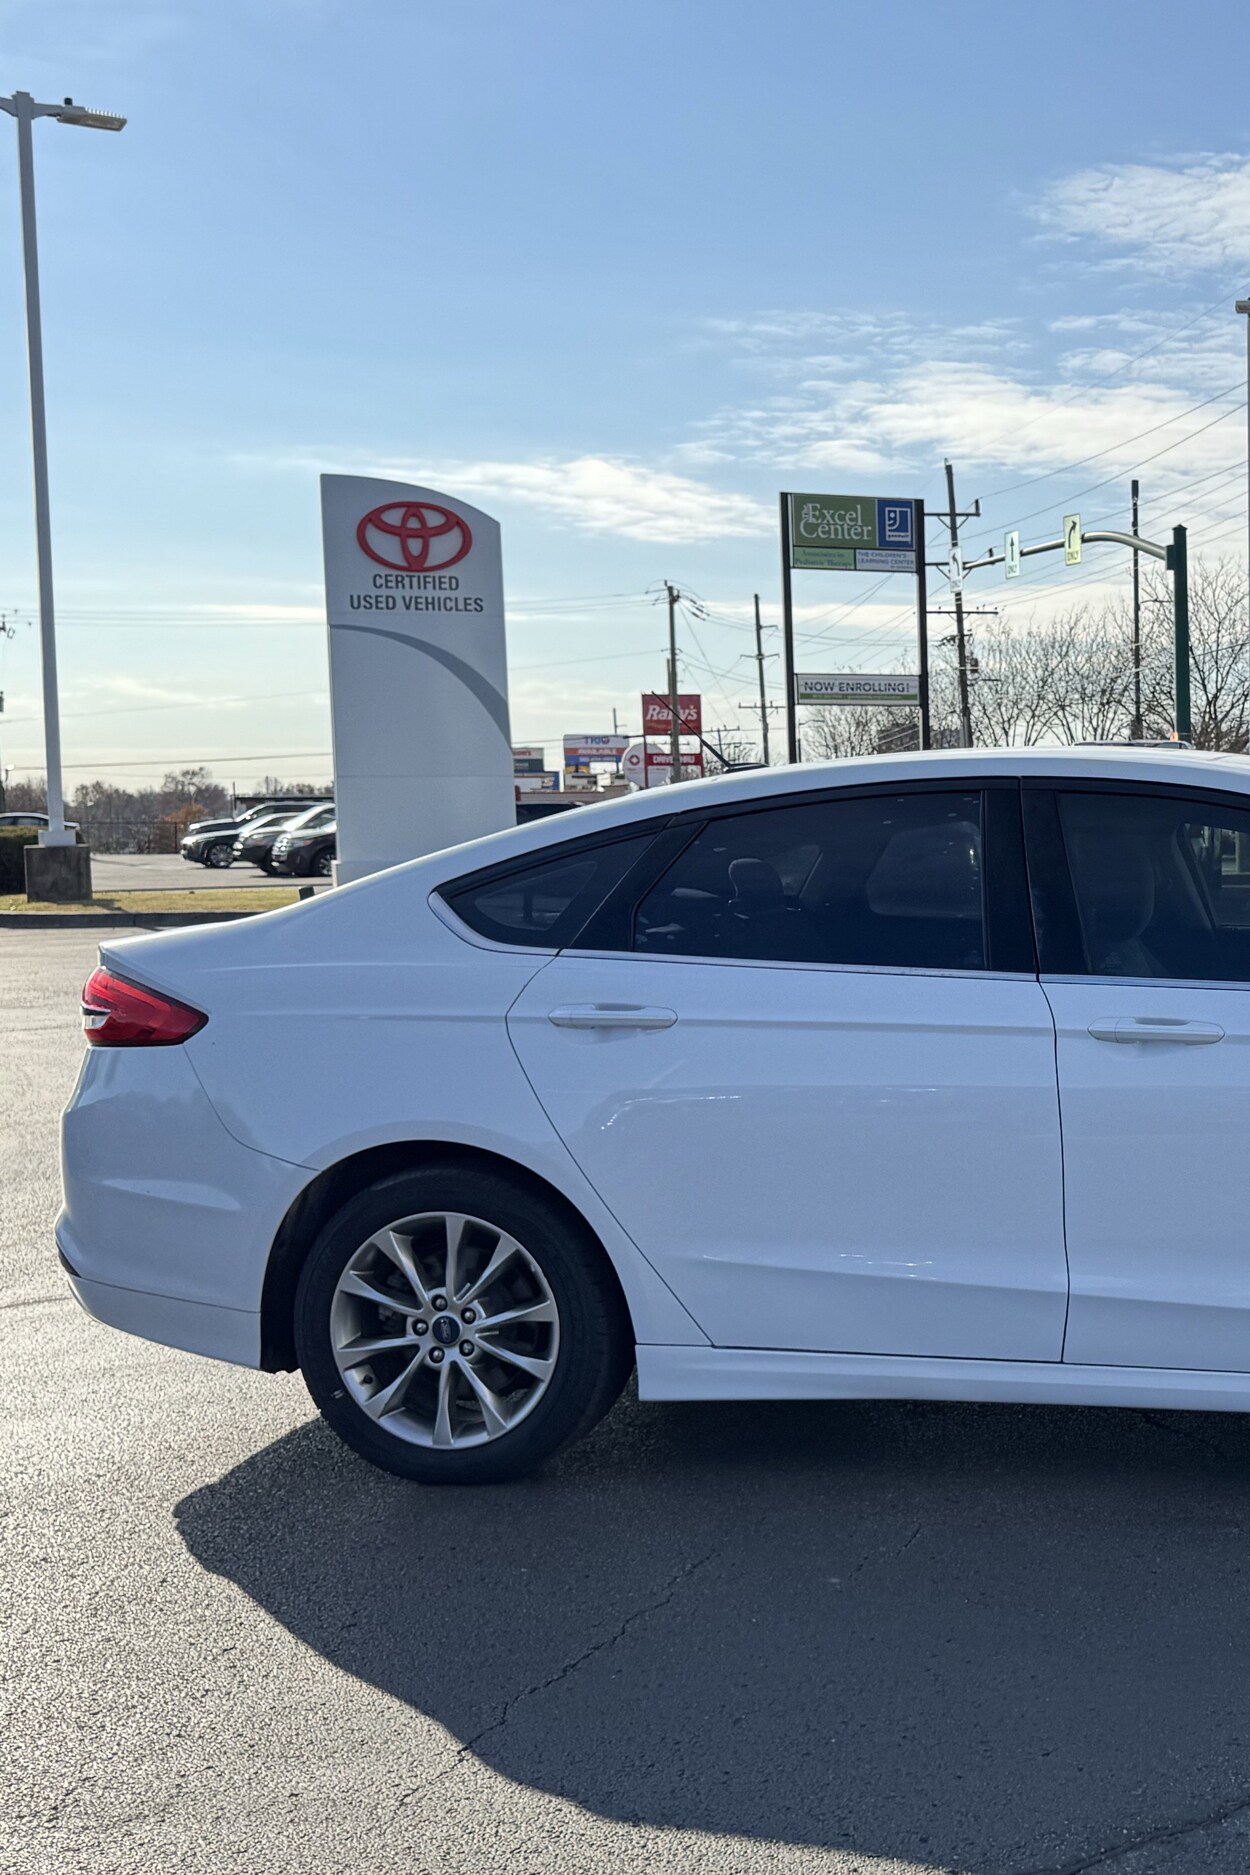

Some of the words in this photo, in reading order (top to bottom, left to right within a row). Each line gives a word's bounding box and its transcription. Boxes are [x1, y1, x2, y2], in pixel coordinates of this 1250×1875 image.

[806, 503, 862, 526] Excel
[800, 519, 872, 540] Center
[1067, 550, 1079, 561] ONLY
[373, 573, 459, 591] CERTIFIED
[350, 594, 396, 610] USED
[402, 595, 484, 612] VEHICLES
[804, 681, 835, 692] NOW
[838, 682, 910, 693] ENROLLING!
[646, 705, 698, 724] Raly's
